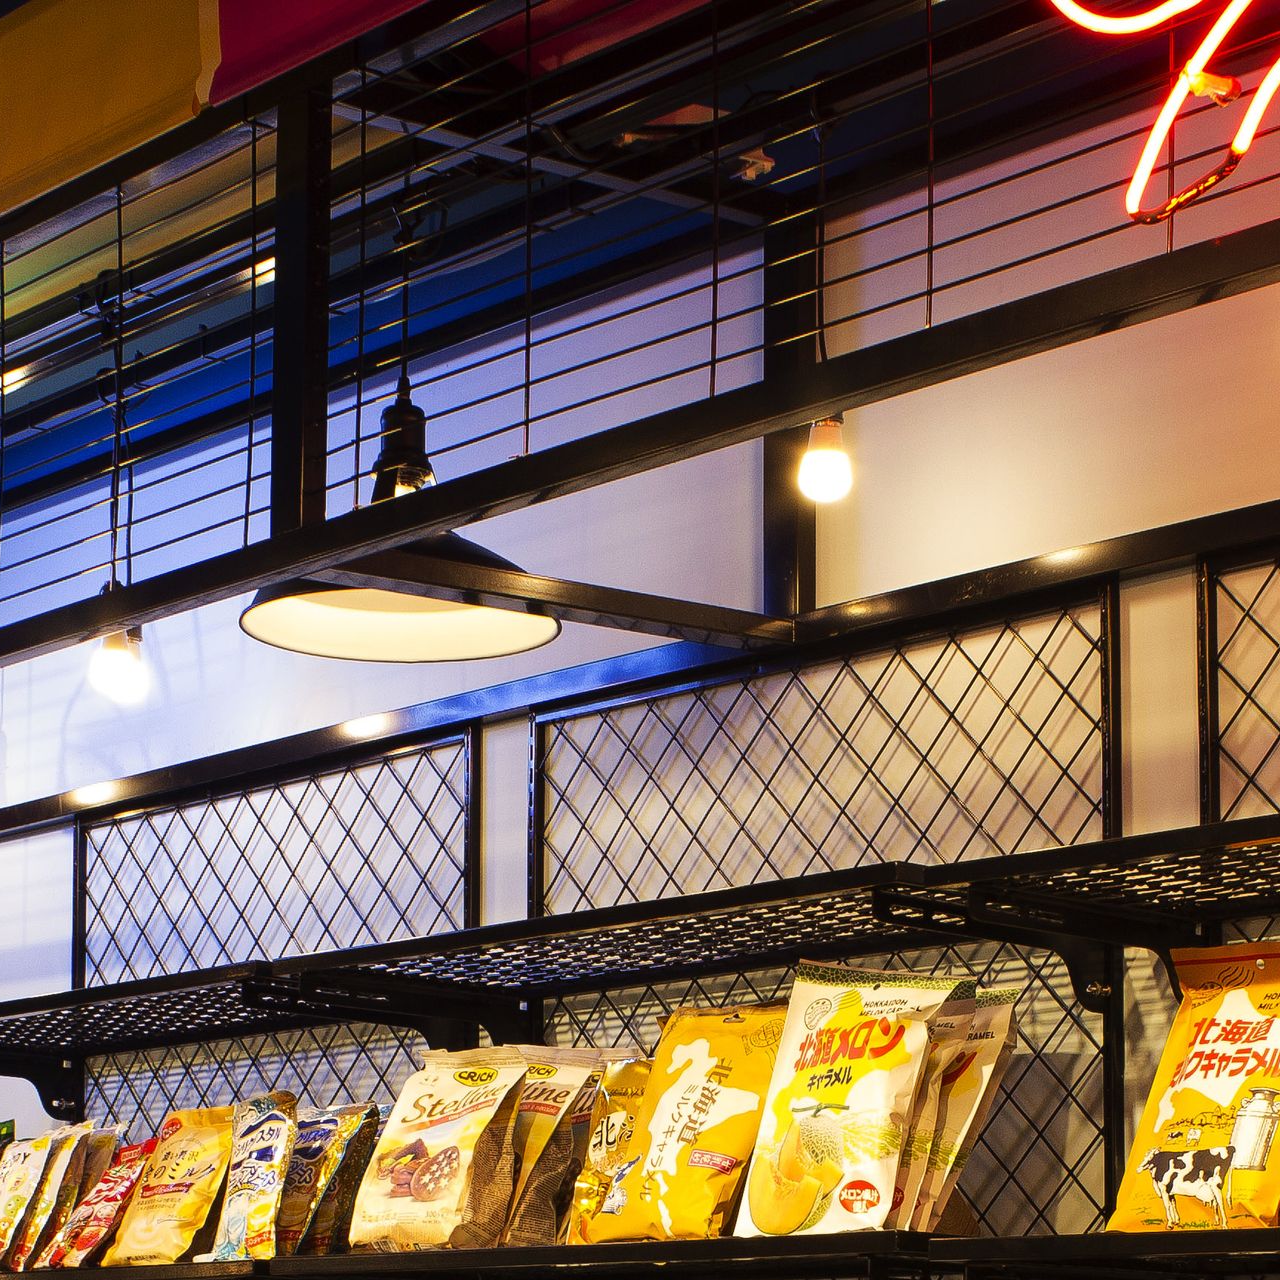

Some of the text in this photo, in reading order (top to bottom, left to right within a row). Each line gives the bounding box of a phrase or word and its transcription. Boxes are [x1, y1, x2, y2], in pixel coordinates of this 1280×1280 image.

[1189, 1014, 1278, 1049] 北海道
[459, 1068, 495, 1083] CRICH
[527, 1064, 554, 1077] RICH
[807, 1066, 853, 1092] キャラメル
